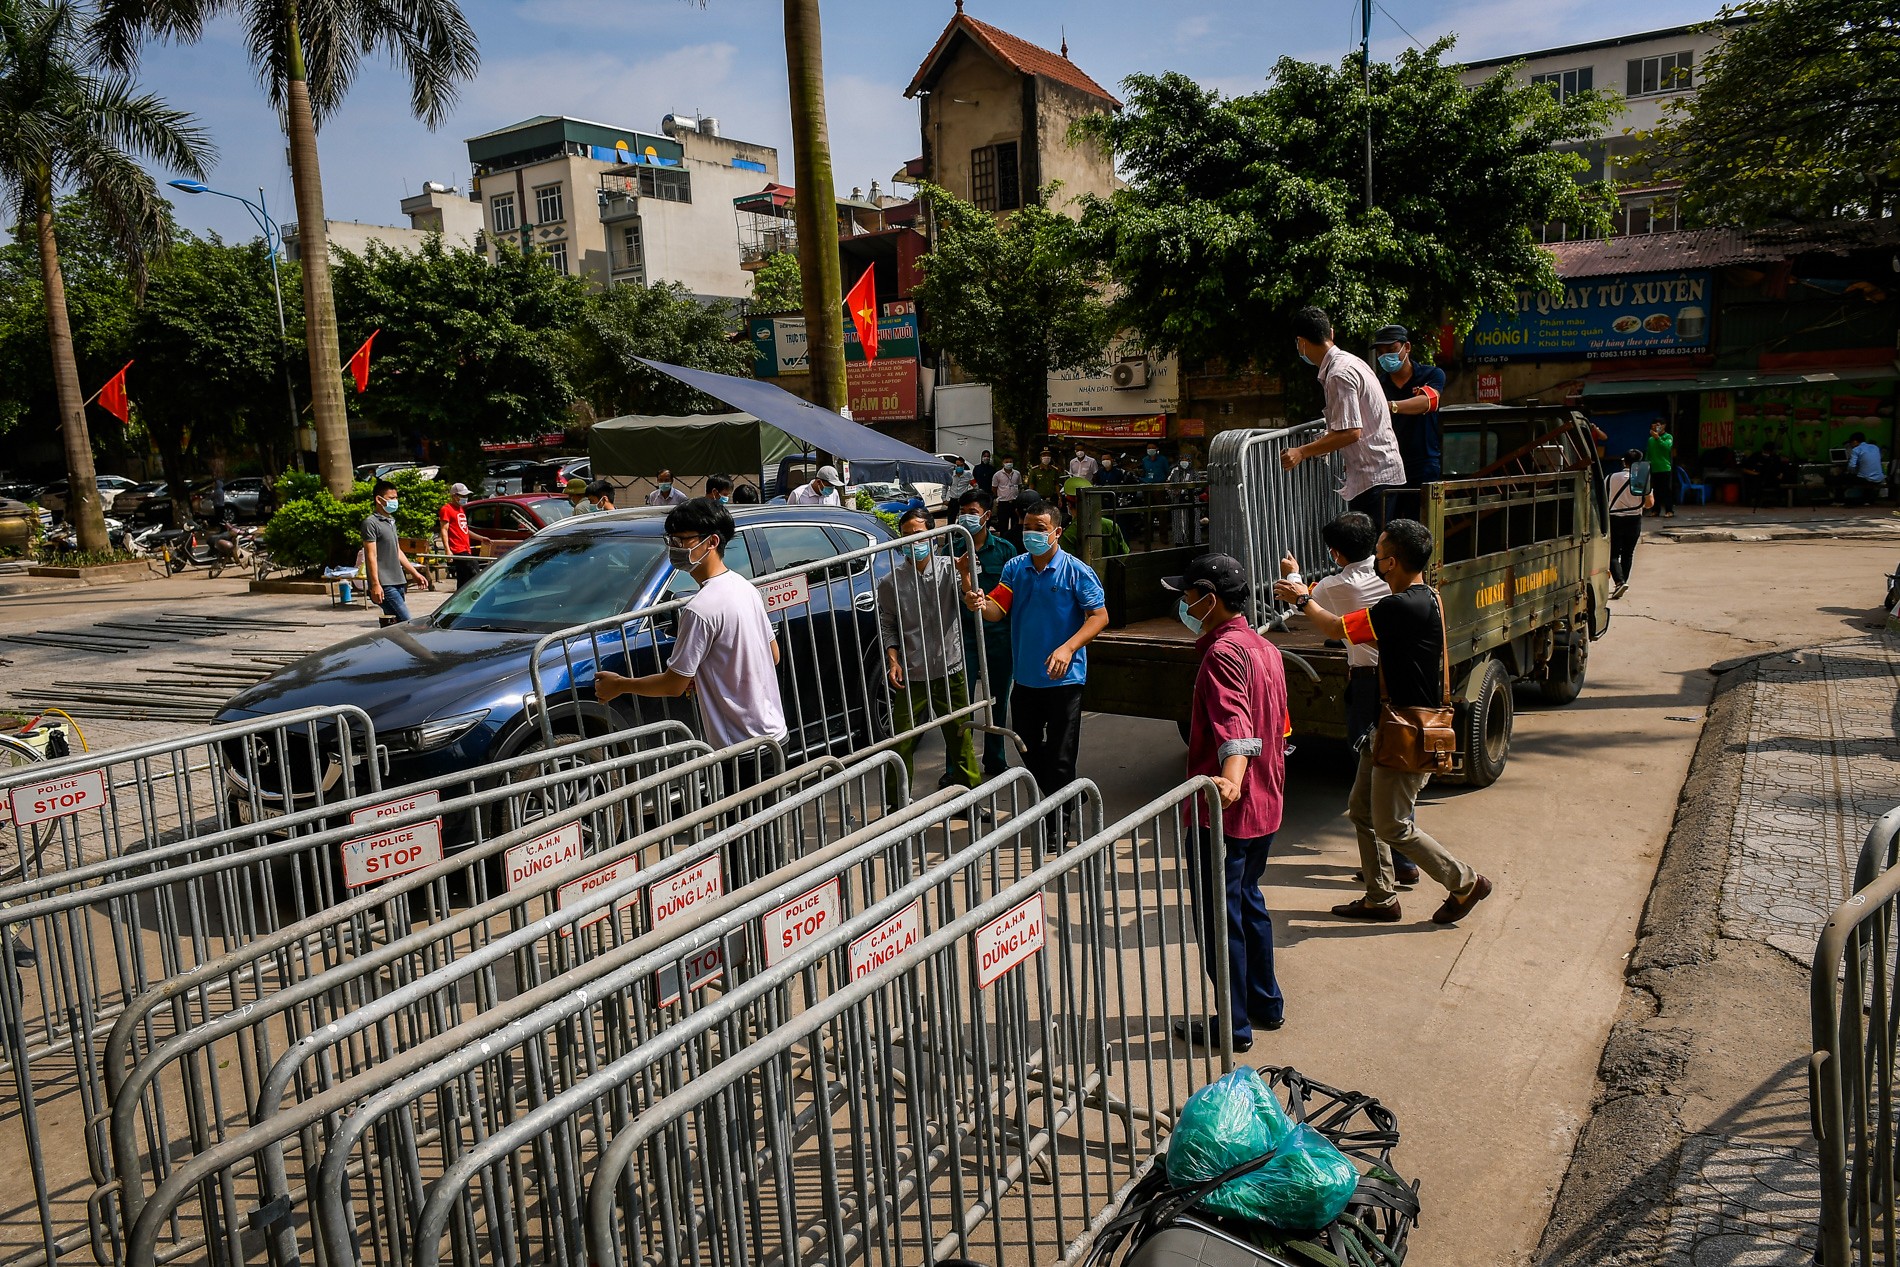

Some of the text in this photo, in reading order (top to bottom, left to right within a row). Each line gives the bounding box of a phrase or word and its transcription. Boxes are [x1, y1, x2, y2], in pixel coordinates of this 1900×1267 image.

[1537, 286, 1593, 316] QUAY
[1597, 278, 1628, 307] TỨ
[1631, 272, 1705, 305] XUYÊN
[851, 391, 899, 411] CẦM ĐỒ
[767, 589, 798, 607] STOP
[769, 581, 794, 593] POLICE
[37, 780, 78, 795] POLICE
[34, 791, 87, 814] STOP
[377, 801, 416, 818] POLICE
[370, 832, 414, 851] POLICE
[527, 835, 561, 856] C.A.H.N
[366, 845, 422, 873] STOP
[513, 843, 577, 883] DỪNG LẠI
[581, 869, 617, 893] POLICE
[671, 869, 703, 892] C.A.H.N
[657, 877, 718, 922] DỪNG LẠI
[785, 893, 820, 920] POLICE
[782, 909, 826, 948] STOP
[871, 918, 903, 948] C.A.H.N
[995, 909, 1026, 937] C.A.H.N
[983, 919, 1040, 971] DỪNG LẠI
